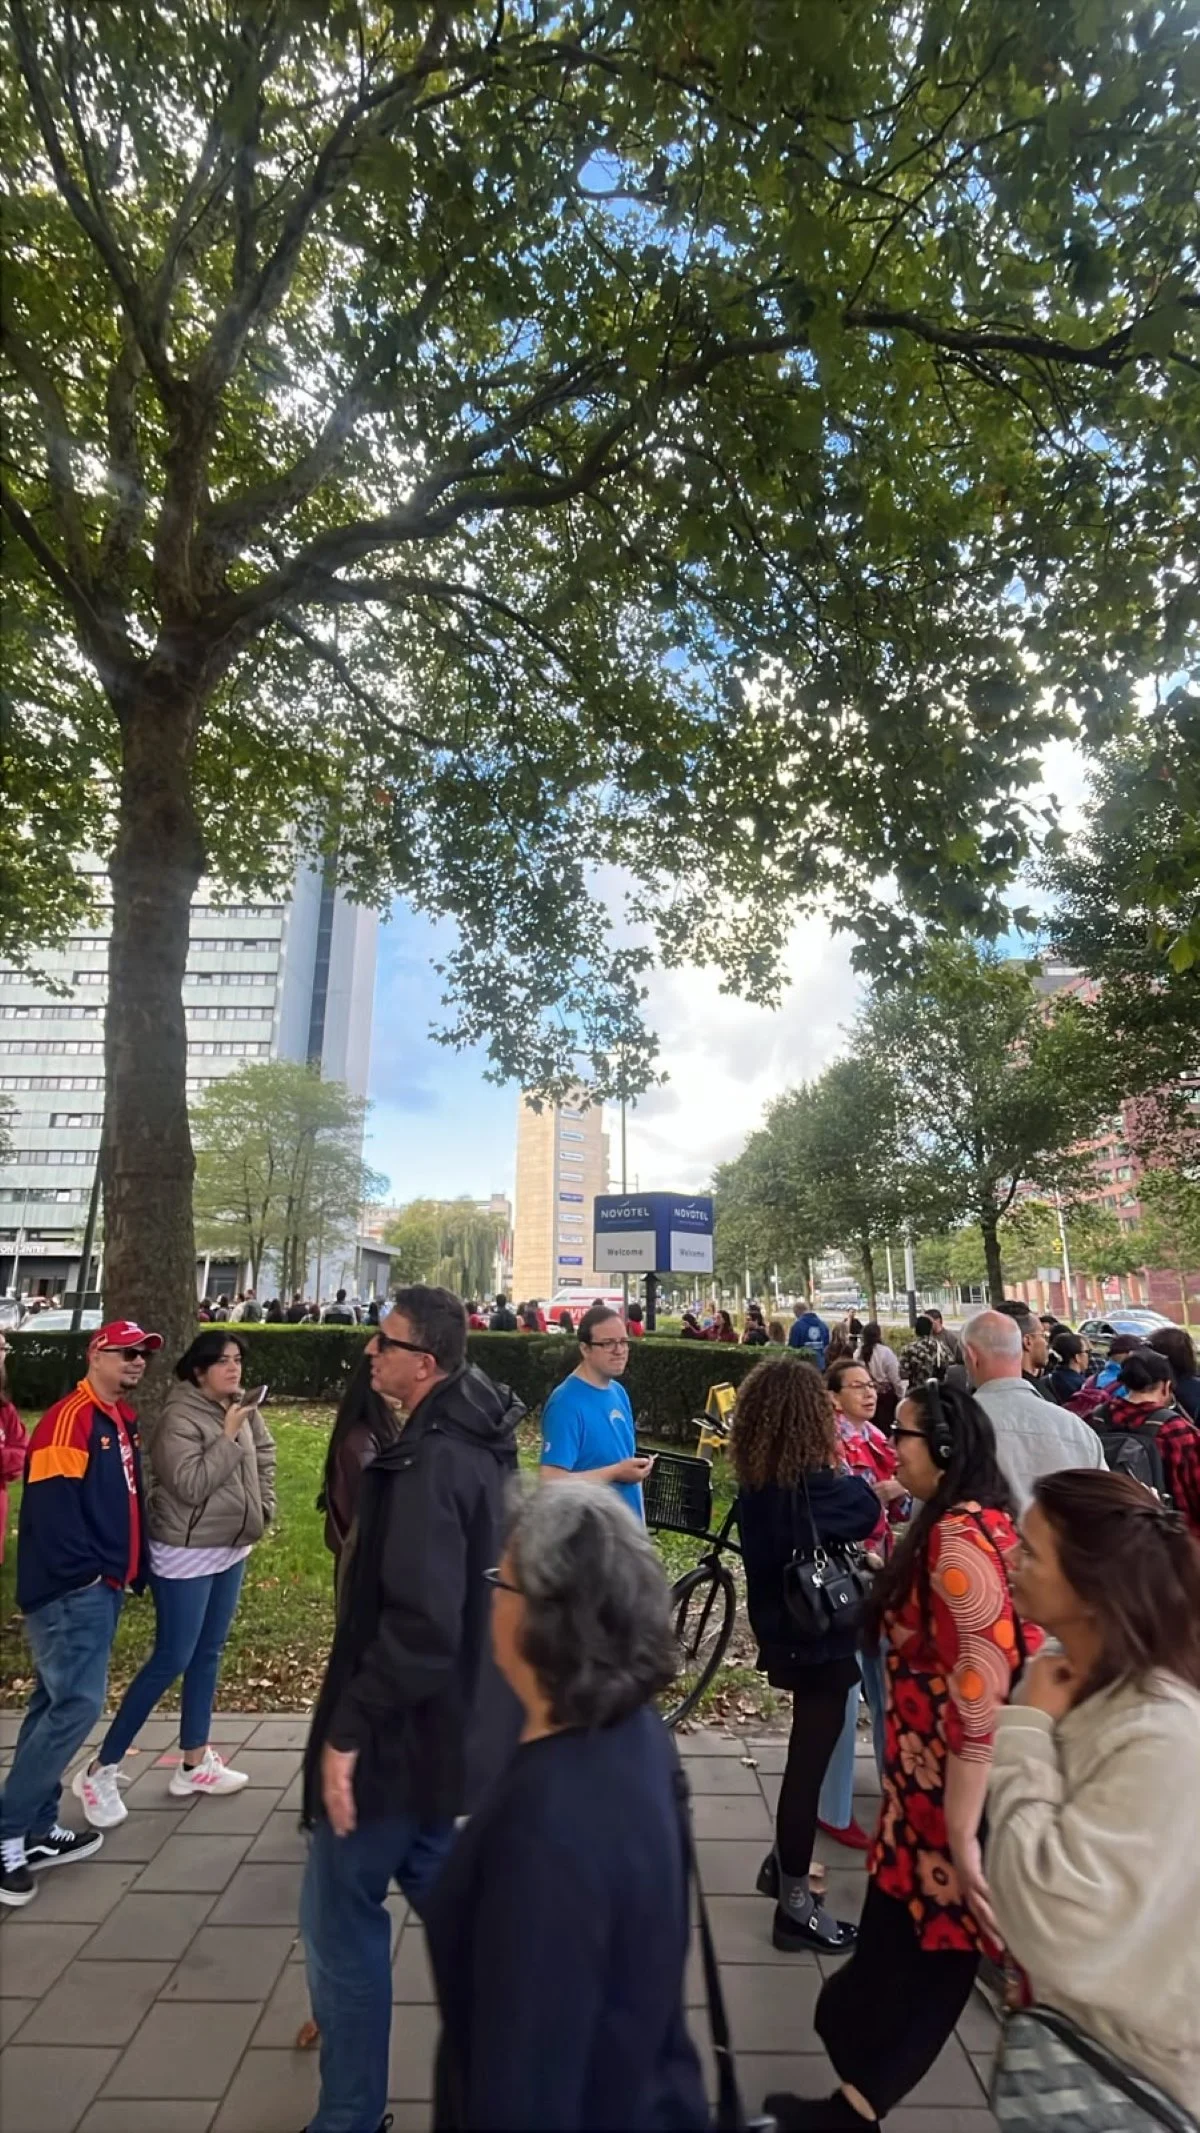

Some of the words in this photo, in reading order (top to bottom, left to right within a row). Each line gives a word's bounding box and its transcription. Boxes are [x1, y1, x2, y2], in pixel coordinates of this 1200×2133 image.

[600, 1207, 650, 1219] NOVOTEL
[673, 1208, 709, 1221] NOVOTEL
[607, 1248, 643, 1256] Welcome
[679, 1248, 705, 1258] Welcome
